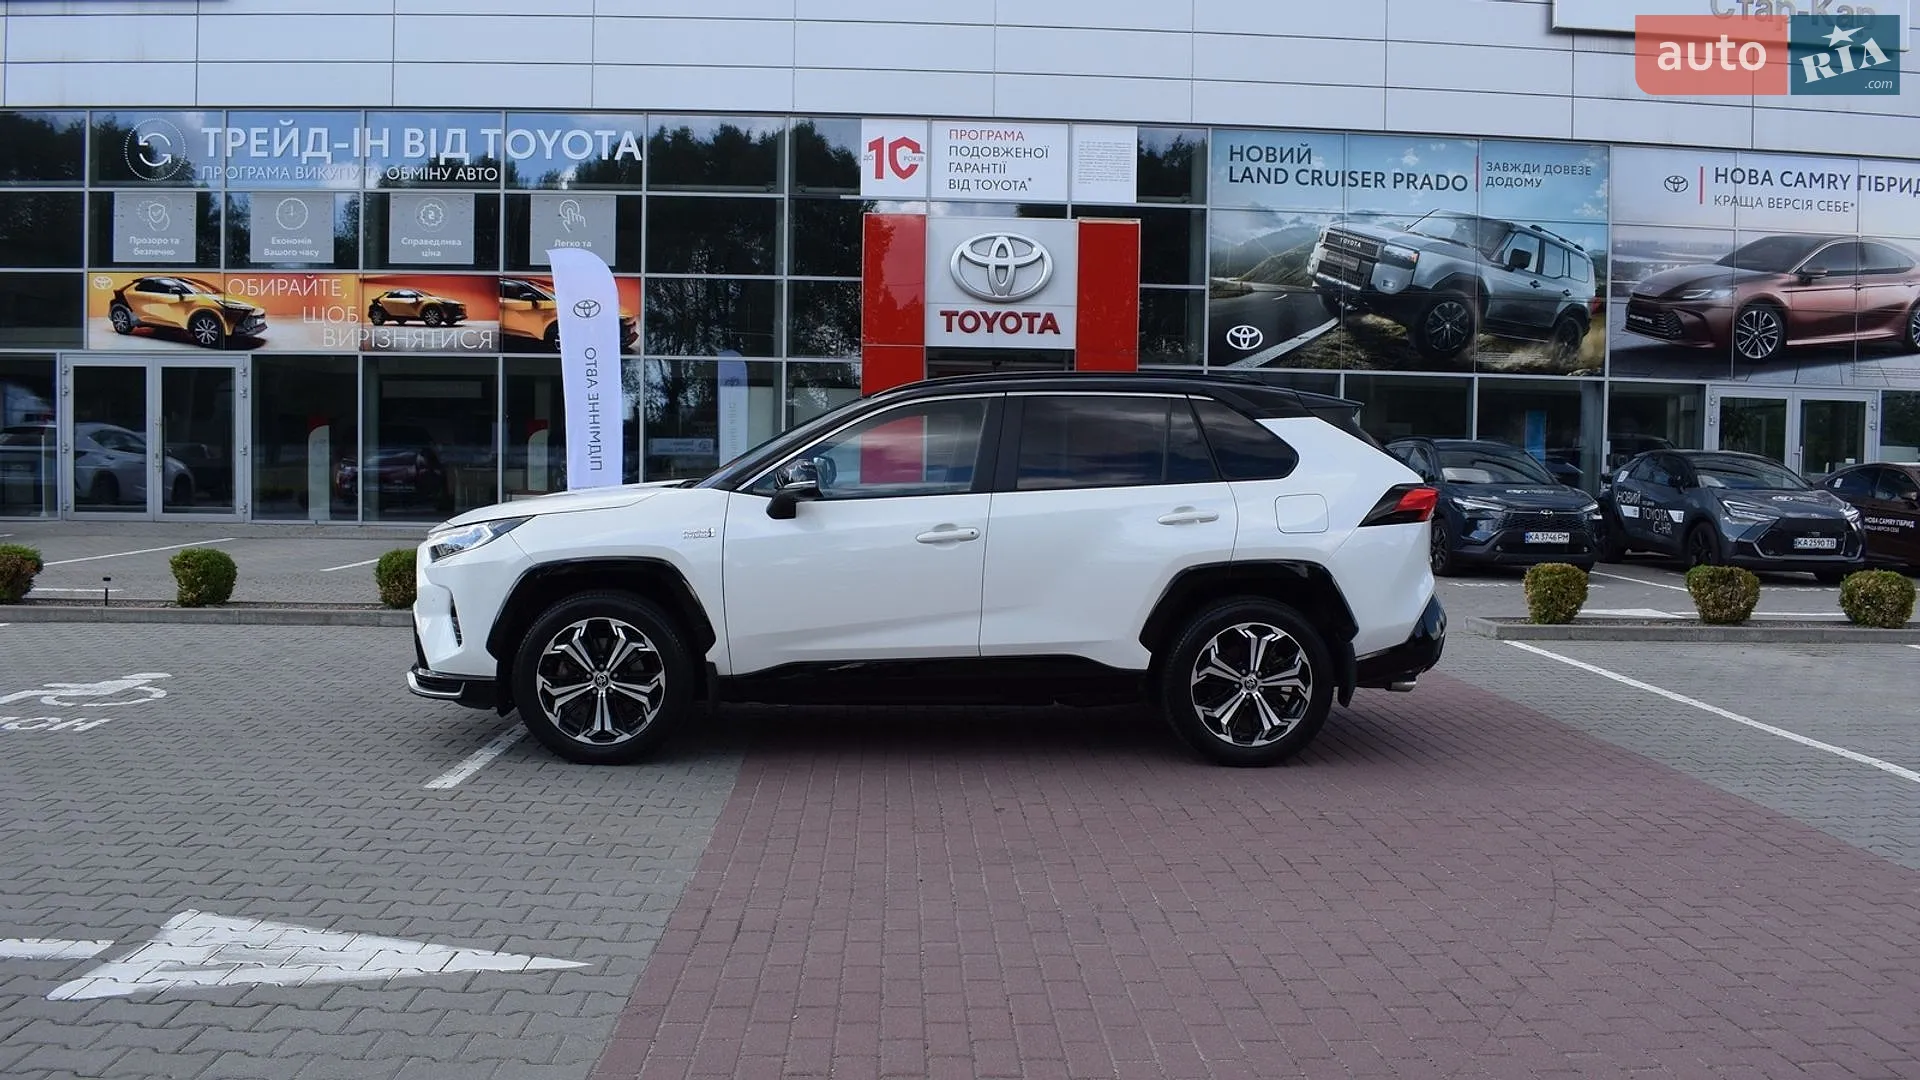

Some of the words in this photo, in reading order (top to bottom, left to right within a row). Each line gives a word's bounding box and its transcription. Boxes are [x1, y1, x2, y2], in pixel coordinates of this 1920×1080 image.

[201, 119, 389, 165] ТРЕЙД-ІН
[404, 128, 470, 165] ВІД
[481, 128, 642, 161] TOYOTA
[949, 129, 1025, 141] ПРОГРАМА
[949, 144, 1050, 159] ПОДОВЖЕНОЇ
[1229, 143, 1312, 165] НОВИЙ
[202, 166, 290, 180] ПРОГРАМА
[295, 166, 360, 181] ВИКУПУ
[366, 167, 382, 180] ТА
[387, 166, 451, 182] ОБМІНУ
[455, 167, 498, 181] АВТО
[949, 161, 1007, 175] ГАРАНТІЇ
[1486, 161, 1540, 176] ЗАВЖДИ
[1543, 162, 1592, 177] ДОВЕЗЕ
[949, 179, 971, 192] ВІД
[1228, 166, 1288, 185] LAND
[1295, 168, 1385, 189] CRUISER
[1393, 172, 1468, 192] PRADO
[1485, 175, 1543, 189] ДОДОМУ
[1714, 167, 1774, 187] НОВА
[1780, 171, 1851, 190] CAMRY
[1714, 195, 1763, 209] КРАЩА
[1768, 197, 1813, 211] ВЕРСІЯ
[129, 236, 169, 246] Прозоро
[271, 236, 312, 245] Економія
[401, 237, 462, 247] Справедлива
[554, 239, 580, 248] Легко
[581, 240, 592, 248] та
[133, 247, 176, 256] безпечно
[263, 248, 297, 257] Вашого
[421, 249, 441, 258] ціна
[227, 273, 348, 299] ОБИРАЙТЕ,
[303, 305, 359, 325] ЩОБ
[940, 310, 1061, 335] TOYOTA
[322, 328, 493, 350] ВИРІЗНЯТИСЯ
